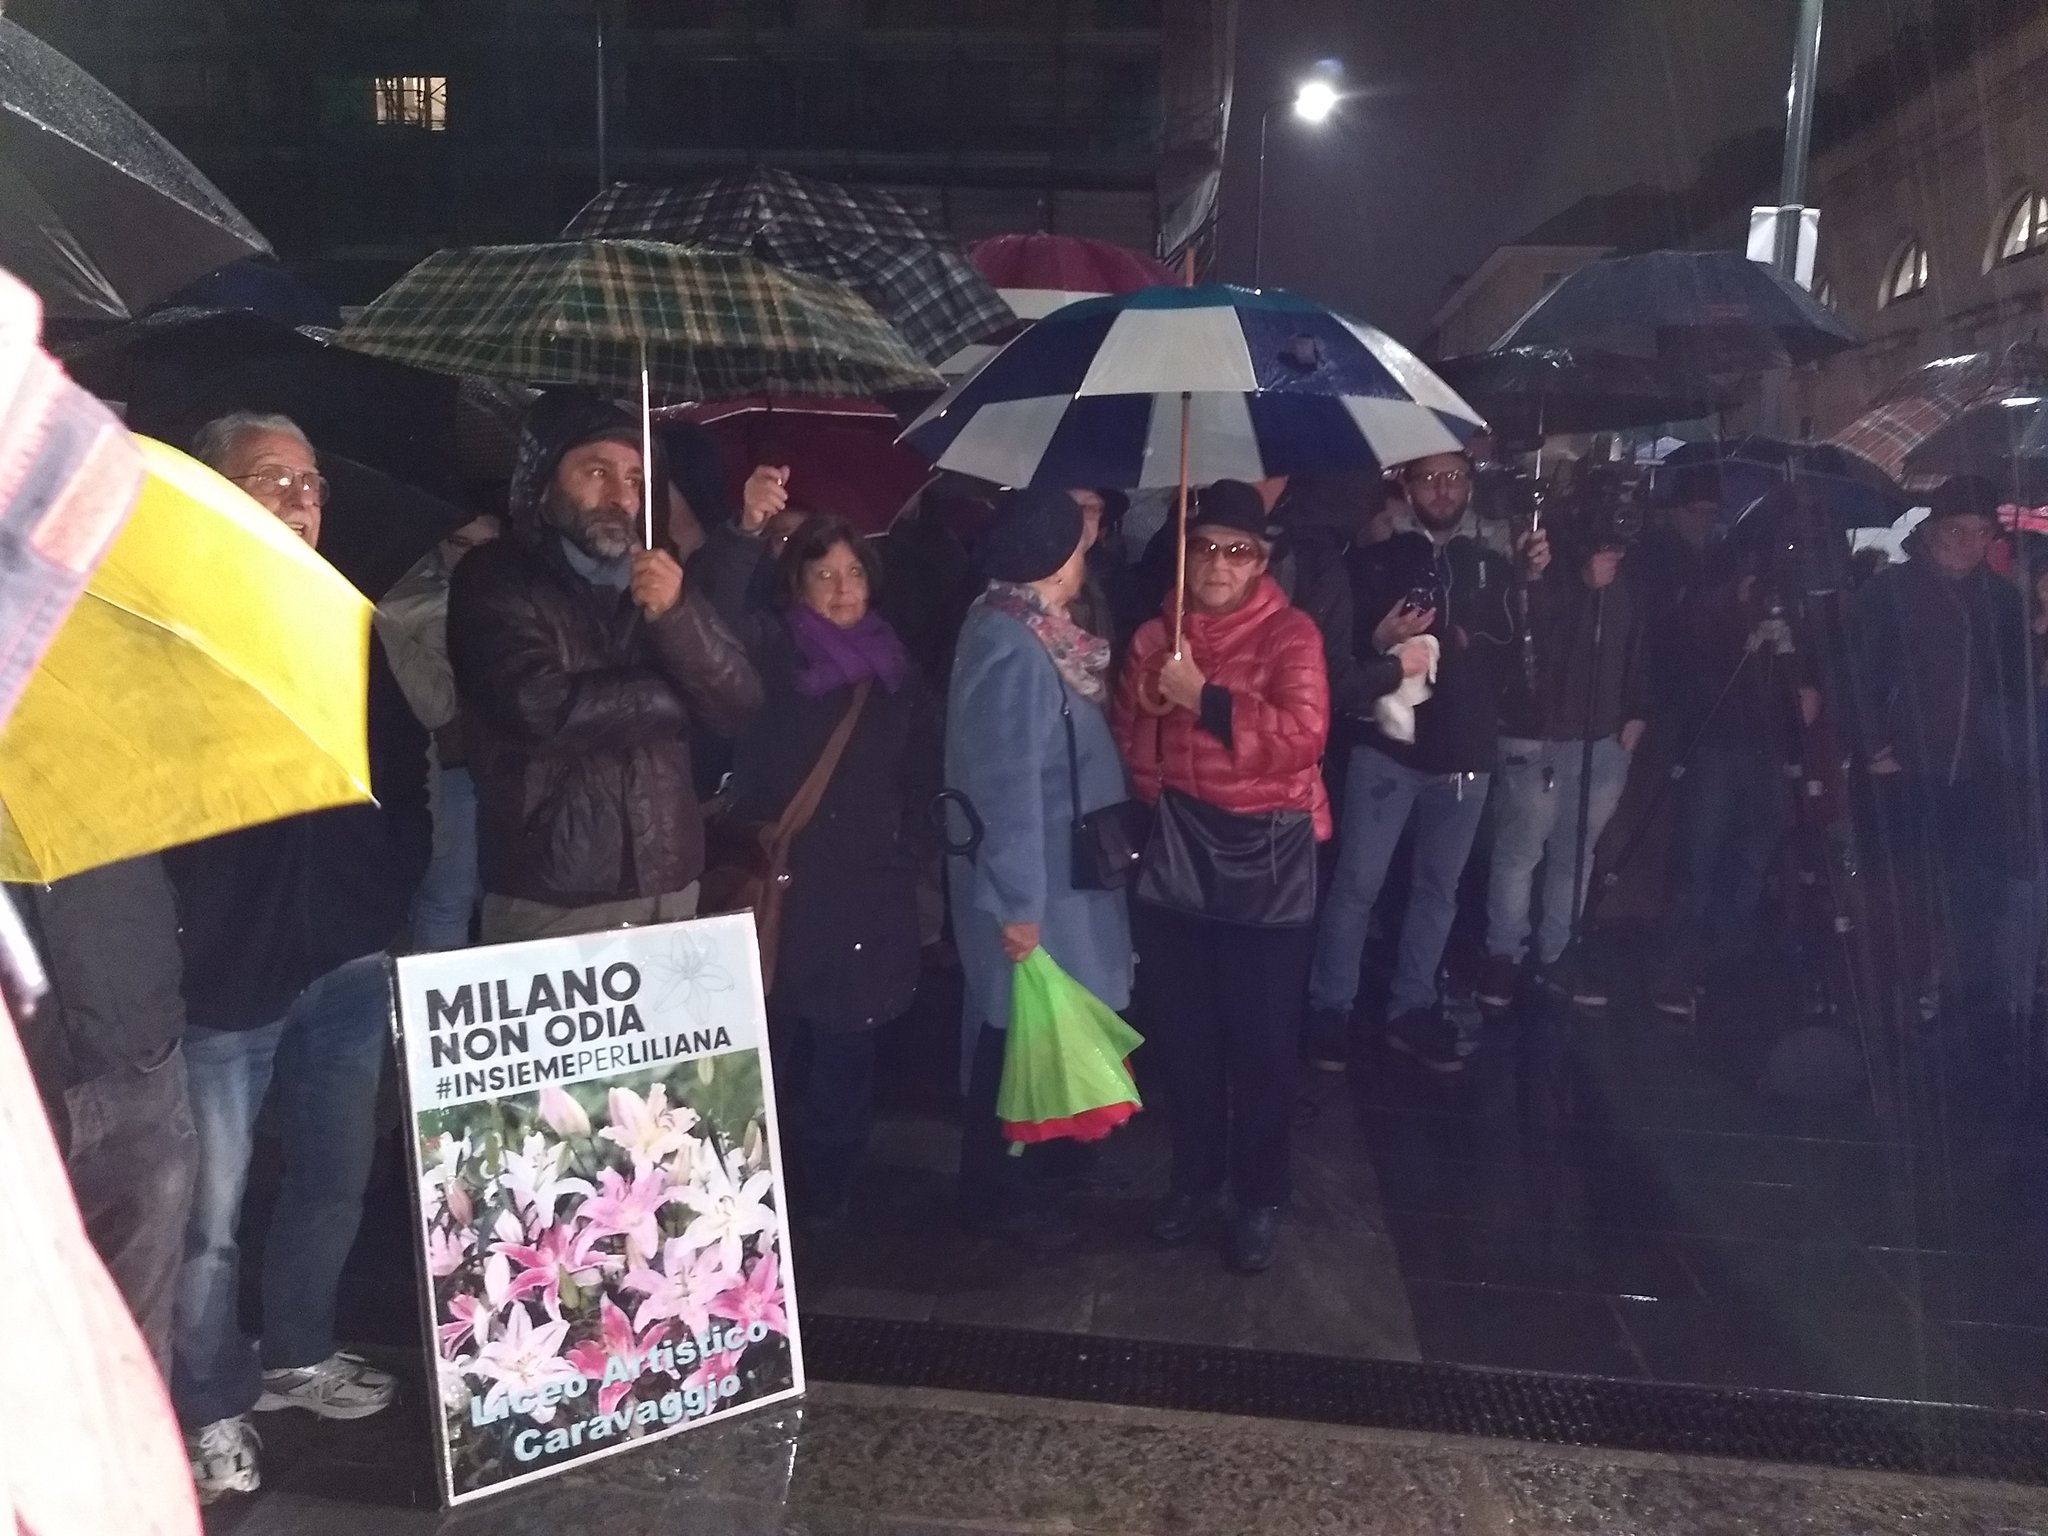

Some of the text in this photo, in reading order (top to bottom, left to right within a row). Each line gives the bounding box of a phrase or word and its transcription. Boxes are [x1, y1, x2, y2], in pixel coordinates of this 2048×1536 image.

[425, 961, 641, 1032] MILANO
[430, 1003, 645, 1068] NON ODIA
[435, 1026, 732, 1099] #INSIEMEPERLILIANA
[470, 1320, 769, 1427] Liceo Artistico
[513, 1371, 741, 1463] Caravaggio
